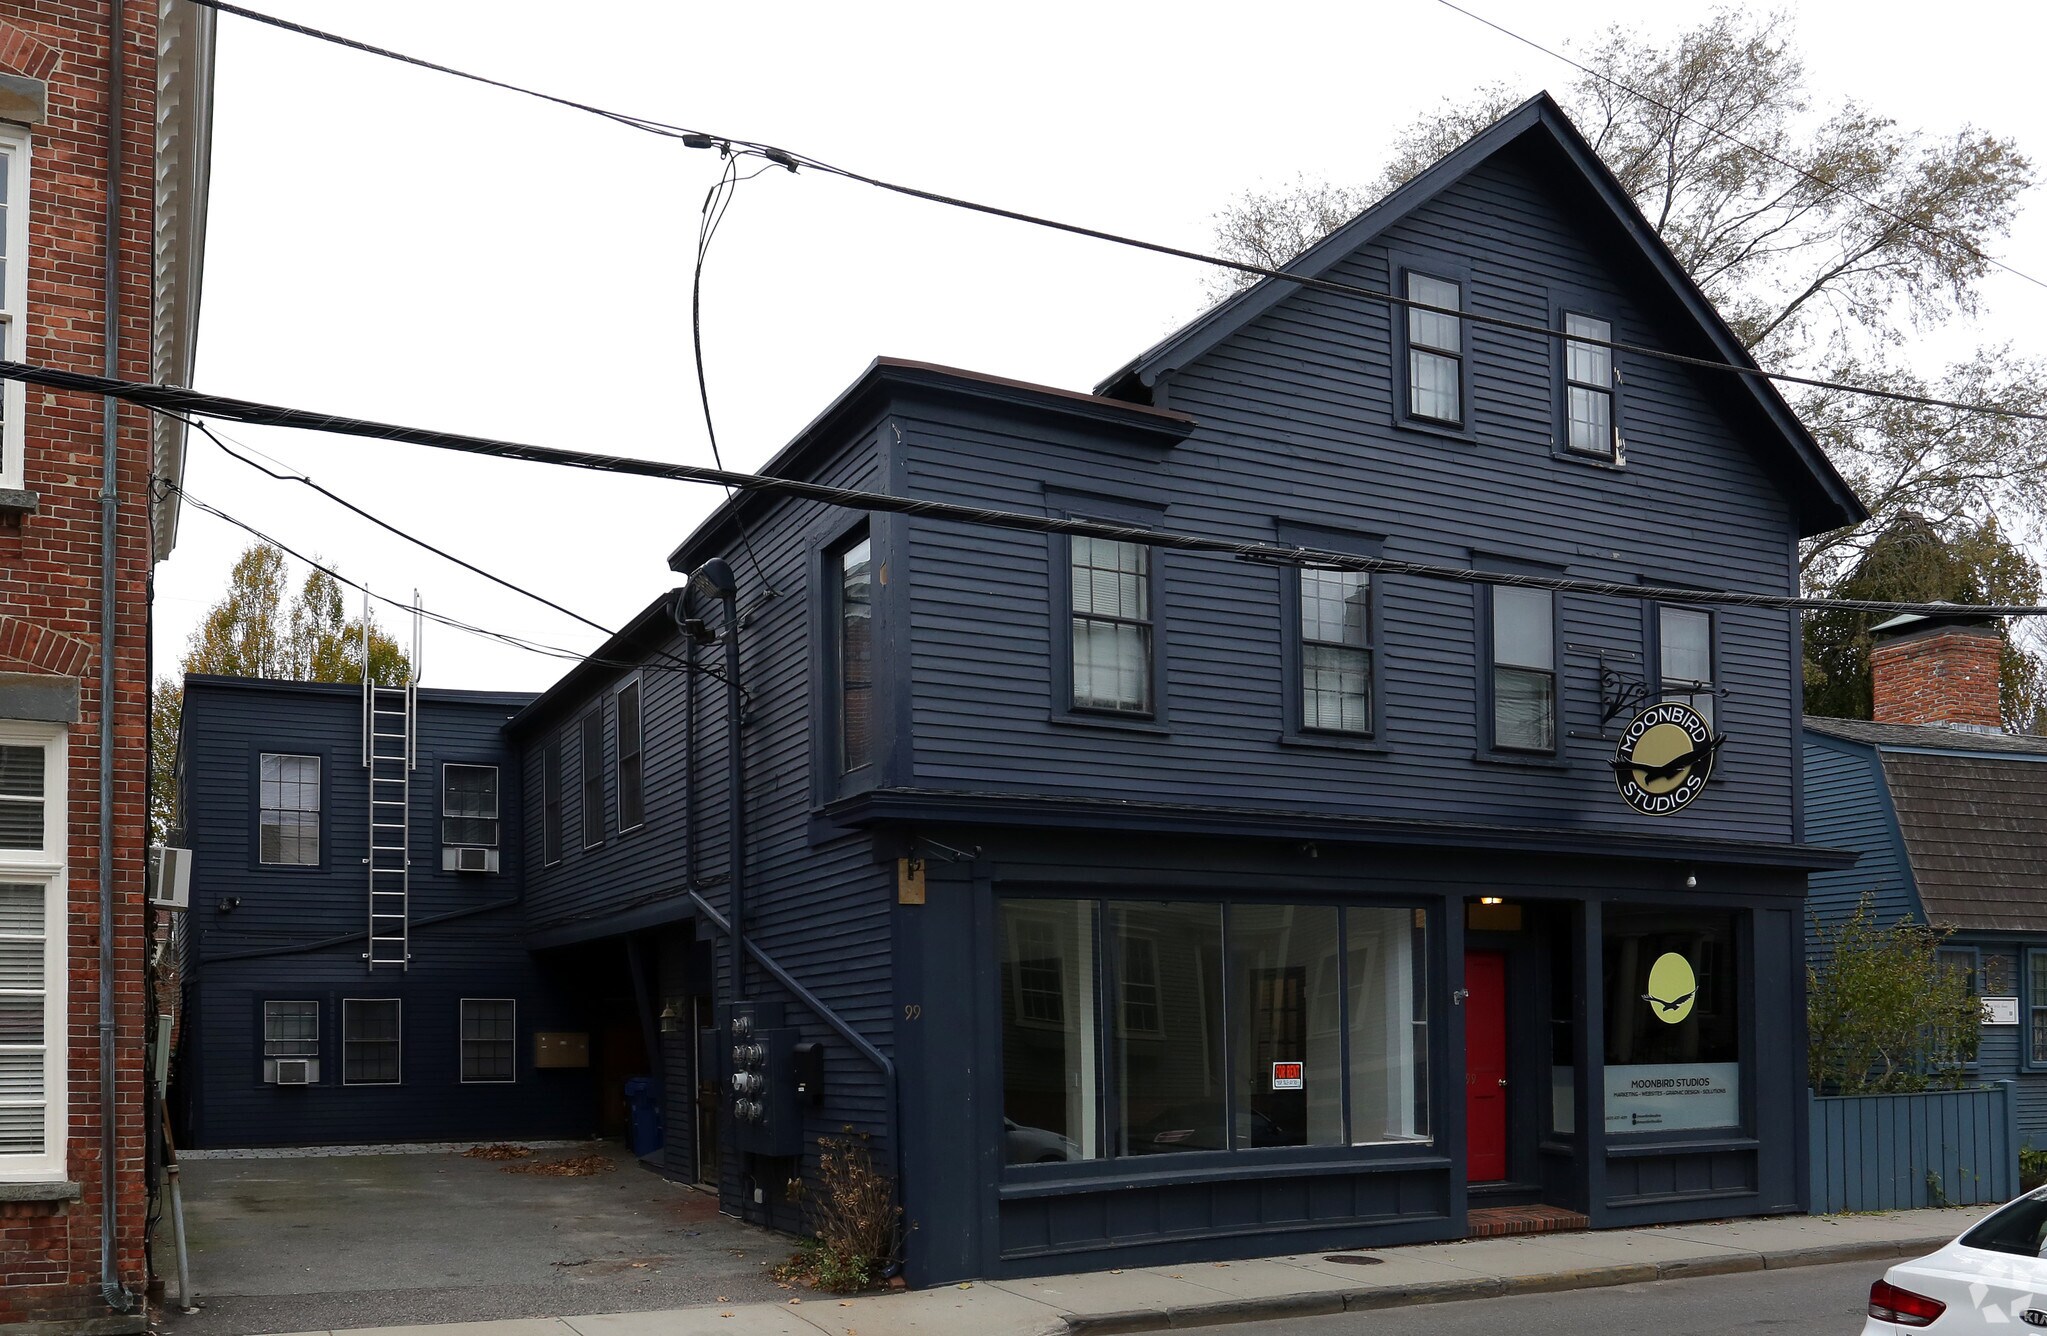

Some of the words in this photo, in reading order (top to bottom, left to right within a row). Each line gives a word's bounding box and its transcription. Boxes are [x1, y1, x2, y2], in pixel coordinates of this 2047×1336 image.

[1621, 706, 1707, 752] MOONBIRD
[1623, 774, 1701, 812] STUDIOS
[904, 1004, 921, 1021] 99
[1631, 1079, 1675, 1089] MOONBIRD
[1676, 1077, 1710, 1087] STUDIOS
[2024, 1311, 2047, 1325] KIA
